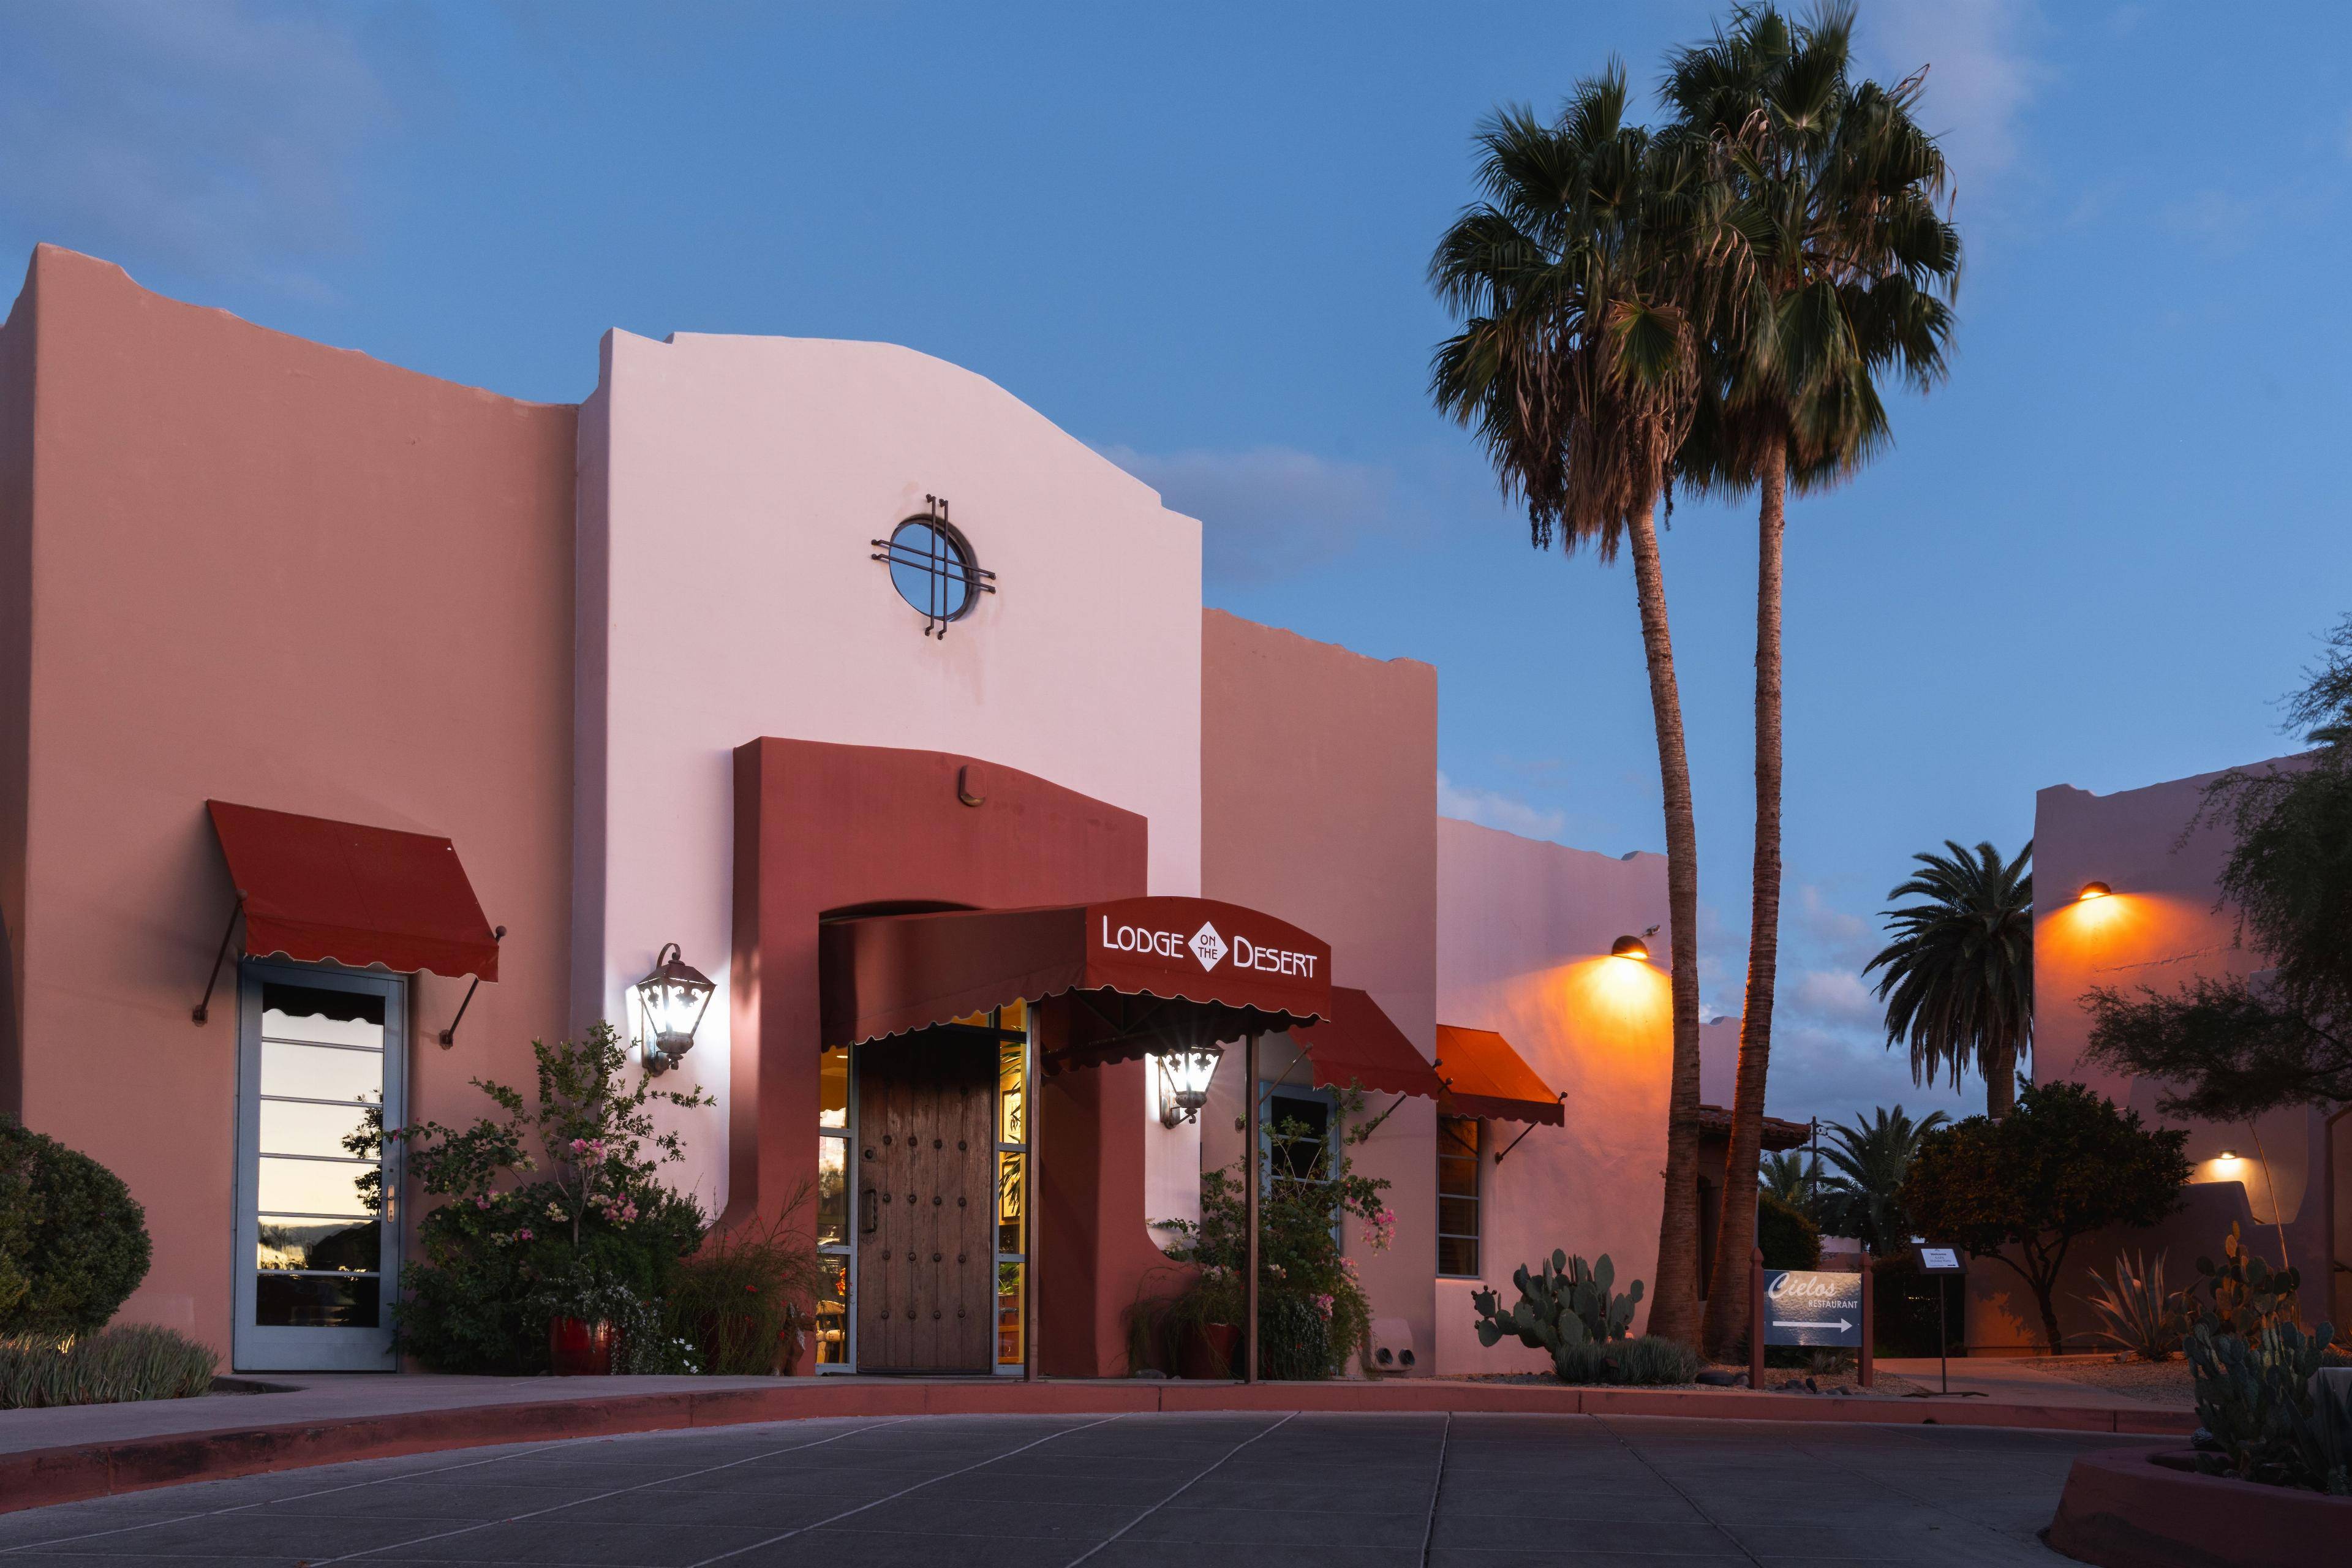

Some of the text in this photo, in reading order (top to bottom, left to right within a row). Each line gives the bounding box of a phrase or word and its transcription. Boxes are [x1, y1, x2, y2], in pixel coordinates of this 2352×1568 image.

[1200, 934, 1216, 946] ON
[1197, 946, 1218, 960] THE
[1768, 1272, 1837, 1299] Cielos
[1808, 1300, 1858, 1309] RESTAURANT
